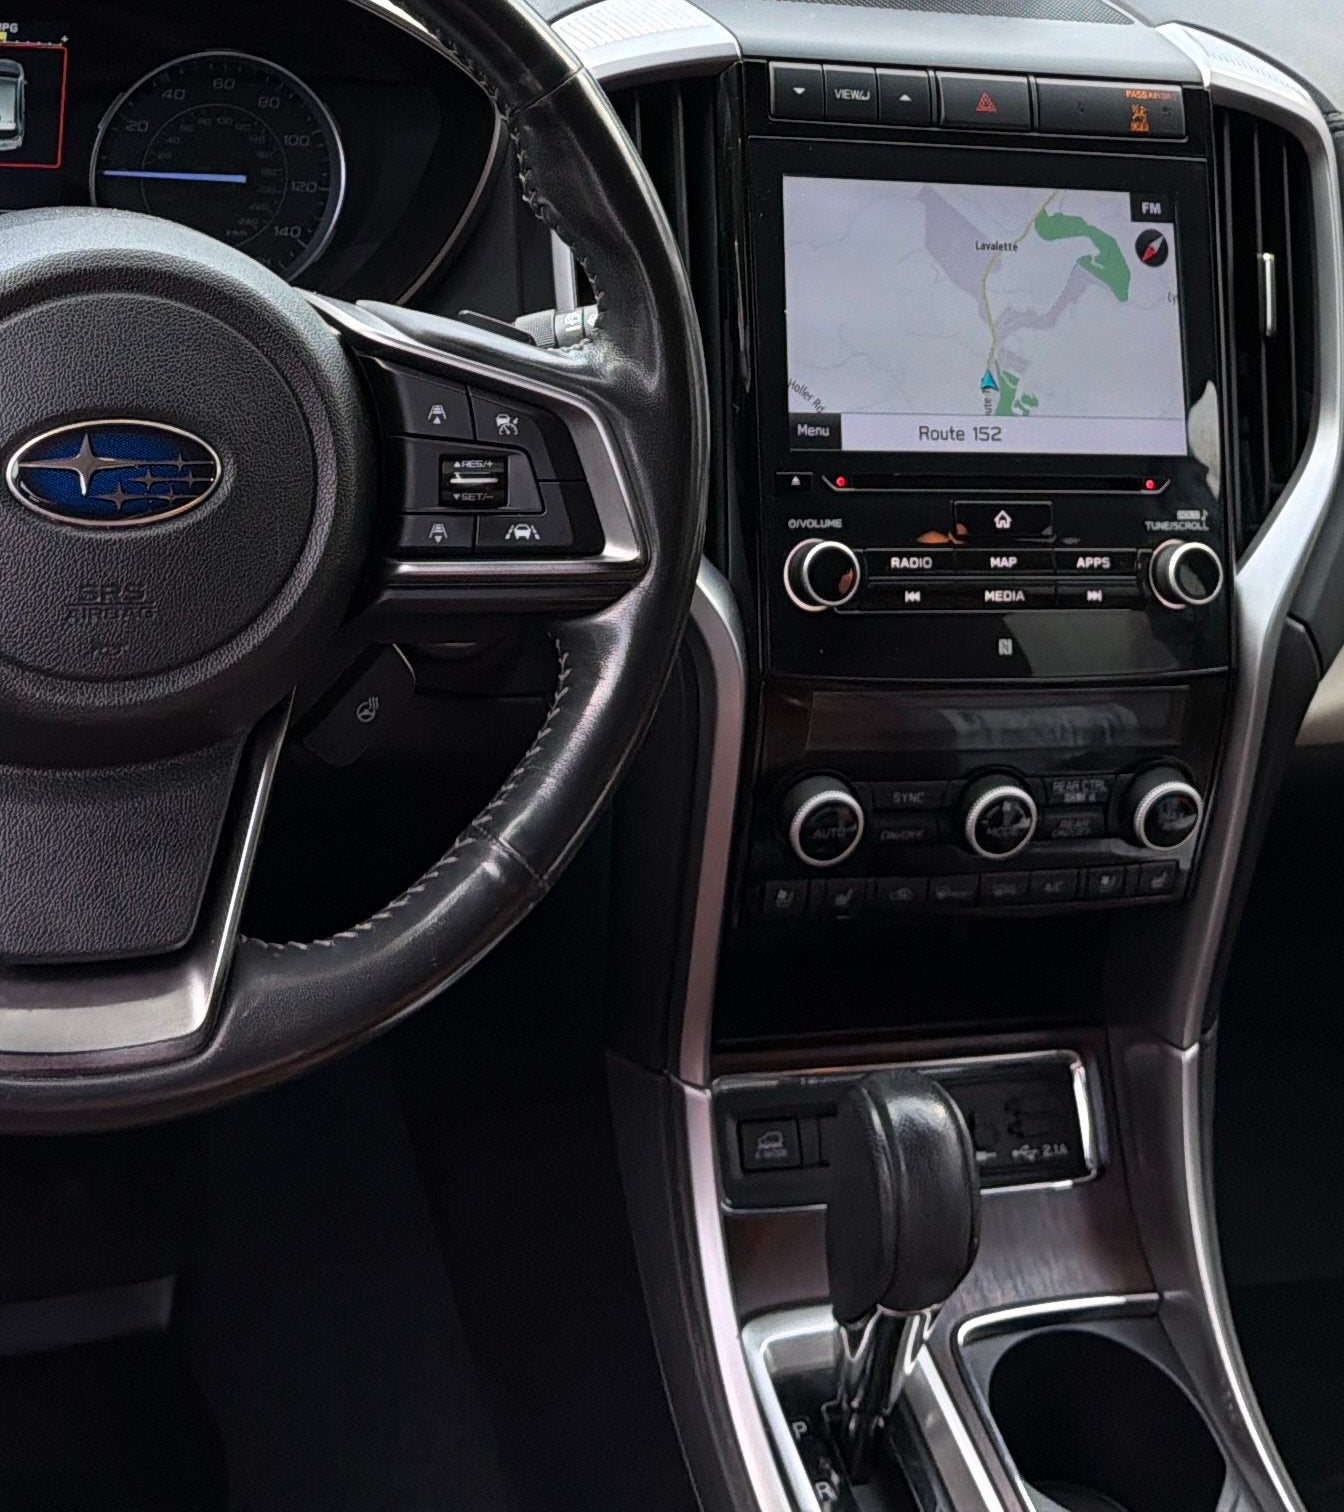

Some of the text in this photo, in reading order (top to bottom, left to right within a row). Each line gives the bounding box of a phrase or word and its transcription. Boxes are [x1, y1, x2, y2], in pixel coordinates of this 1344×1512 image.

[212, 78, 236, 90] 60
[161, 88, 186, 100] 40
[258, 96, 281, 109] 80
[126, 120, 149, 132] 20
[284, 134, 311, 146] 100
[290, 180, 318, 193] 120
[1141, 202, 1162, 216] FM
[274, 225, 302, 239] 140
[975, 239, 1019, 252] Lavalette
[797, 423, 830, 438] Menu
[918, 425, 1003, 443] Route 152
[890, 556, 933, 570] RADIO
[990, 556, 1017, 569] MAP
[1076, 556, 1111, 570] APPS
[984, 589, 1025, 603] MEDIA
[892, 791, 925, 805] SYNC
[812, 826, 846, 838] AUTO
[792, 1419, 808, 1441] P
[815, 1480, 834, 1502] R
